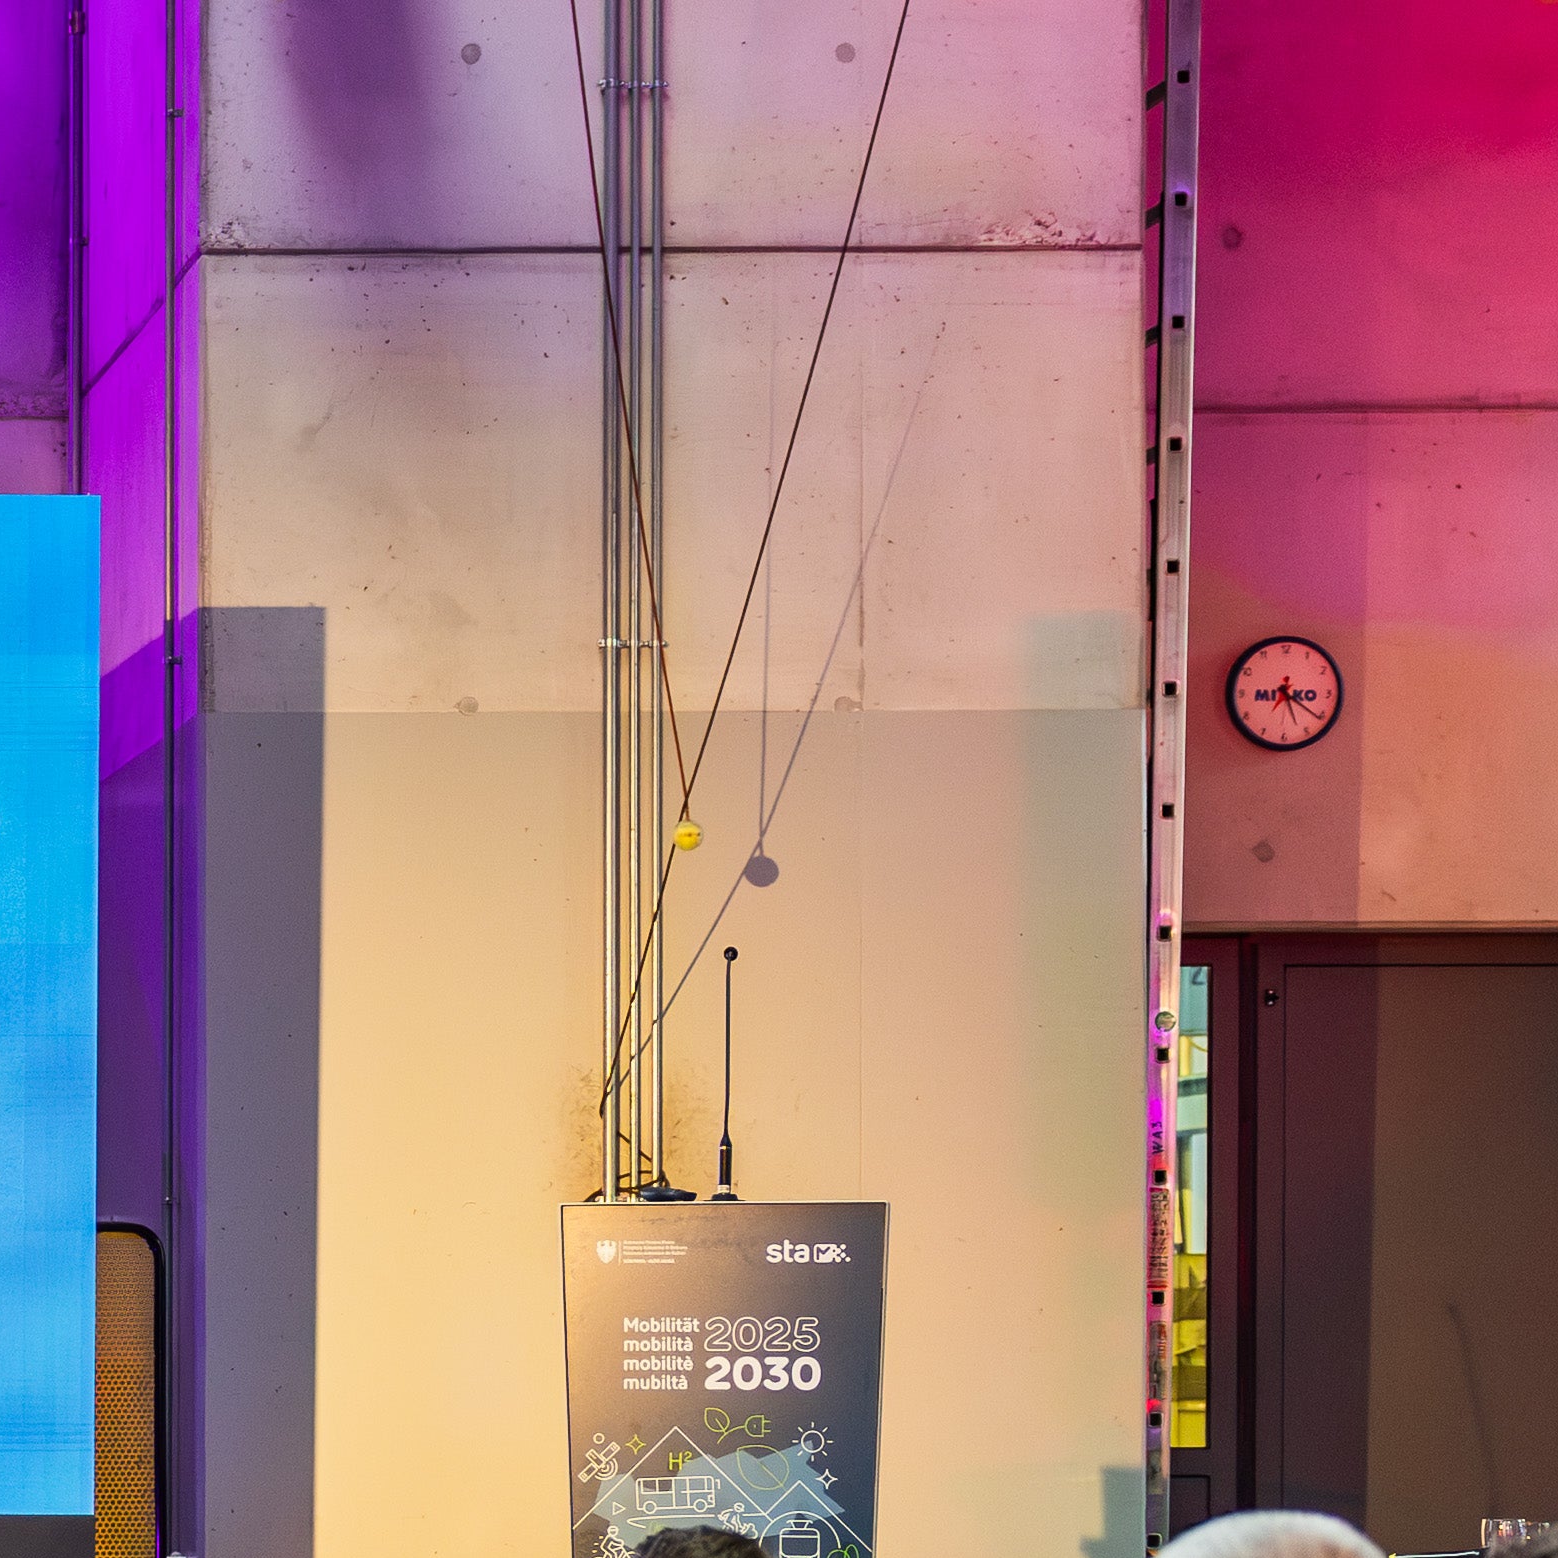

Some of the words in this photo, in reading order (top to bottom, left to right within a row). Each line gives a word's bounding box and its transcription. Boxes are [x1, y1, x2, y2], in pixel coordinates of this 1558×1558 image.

[766, 1239, 810, 1264] sta
[623, 1317, 700, 1334] Mobilität
[704, 1316, 821, 1353] 2025
[623, 1335, 694, 1352] mobilità
[623, 1373, 689, 1391] mubiltà
[704, 1356, 822, 1391] 2030
